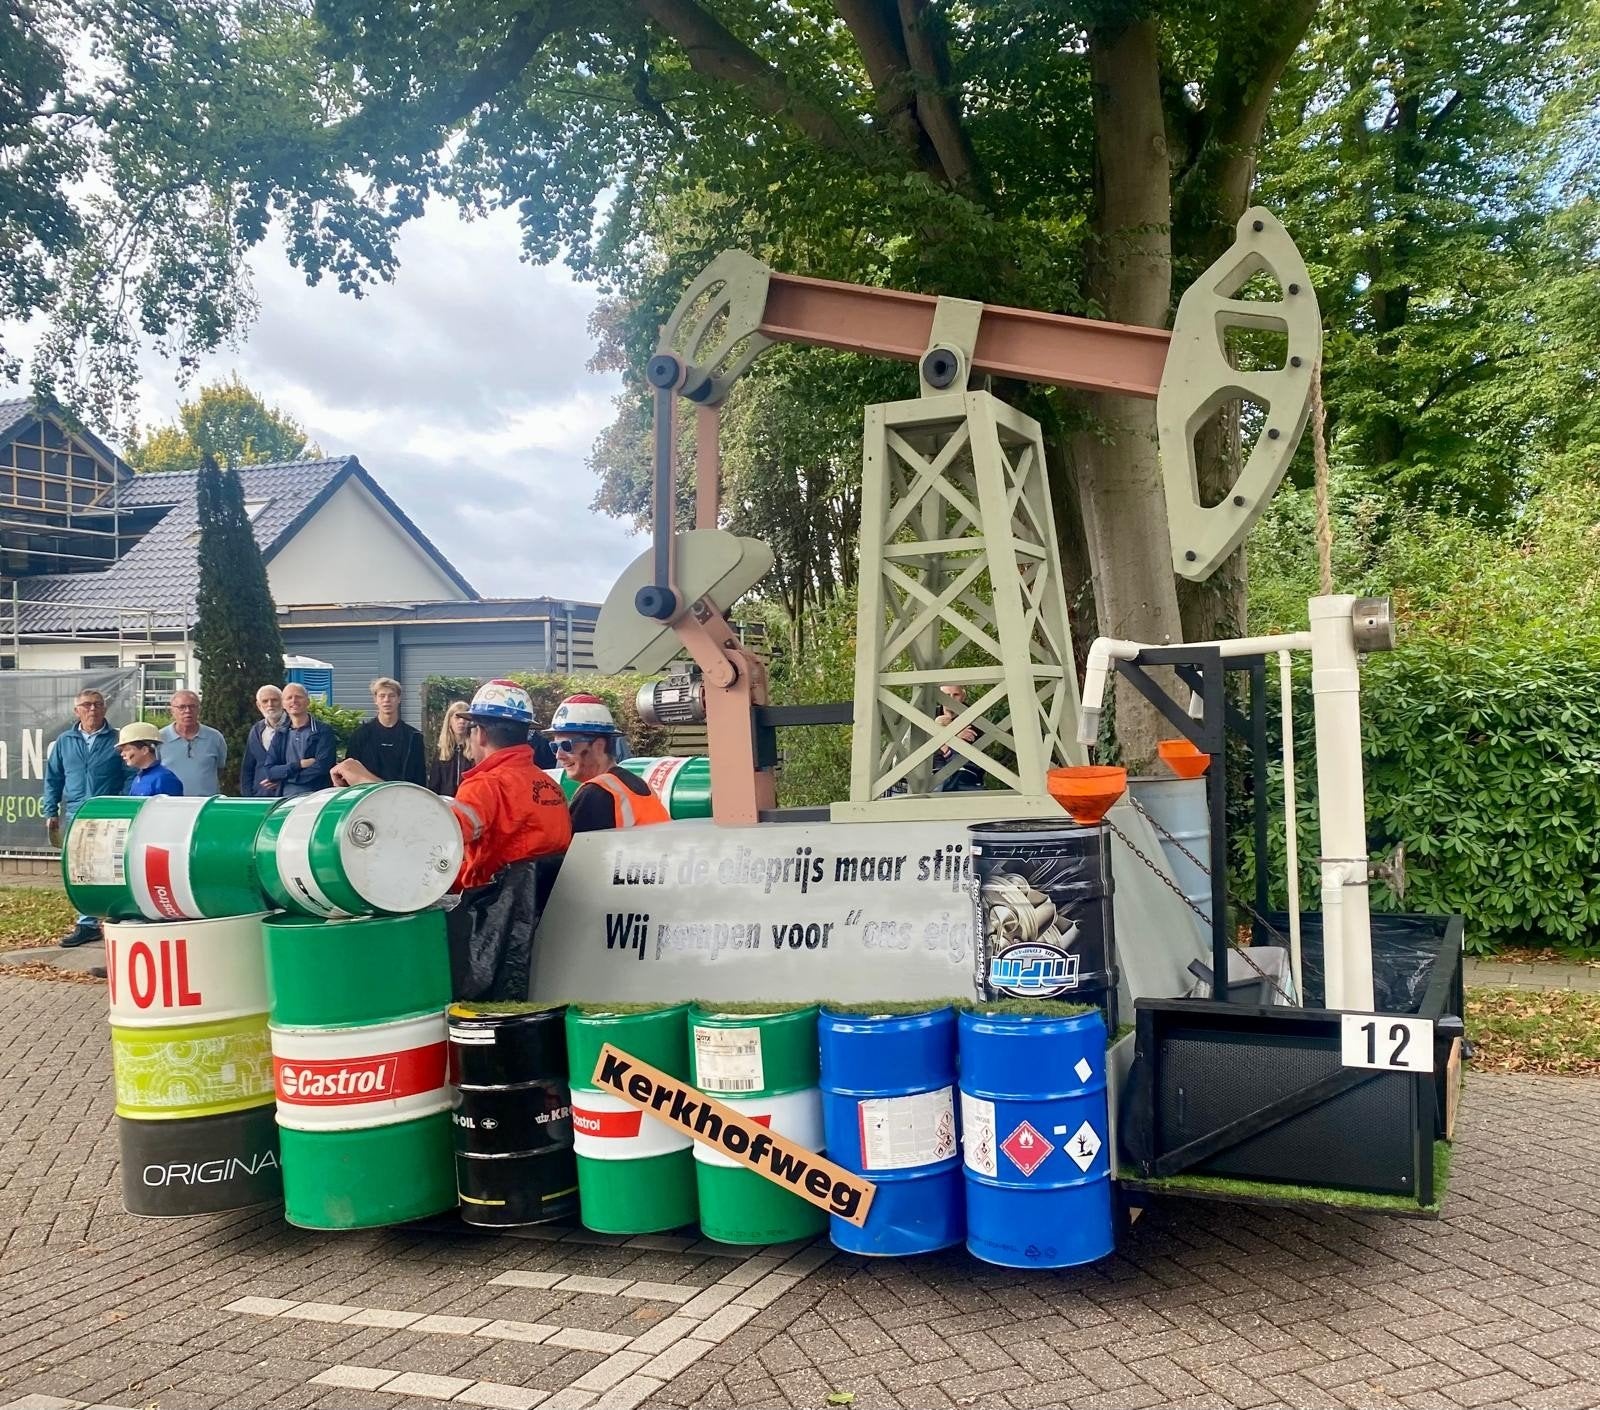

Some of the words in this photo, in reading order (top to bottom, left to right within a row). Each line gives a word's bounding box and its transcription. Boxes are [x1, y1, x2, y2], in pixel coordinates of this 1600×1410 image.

[0, 796, 61, 823] groe
[834, 855, 907, 882] maar
[153, 885, 179, 917] astrol
[606, 913, 649, 960] Wij
[772, 923, 834, 949] voor
[128, 939, 202, 1009] OIL
[1361, 1022, 1411, 1067] 12
[298, 1064, 386, 1096] Castrol
[600, 1053, 862, 1218] Kerkhofweg
[143, 1150, 282, 1187] ORIGINA
